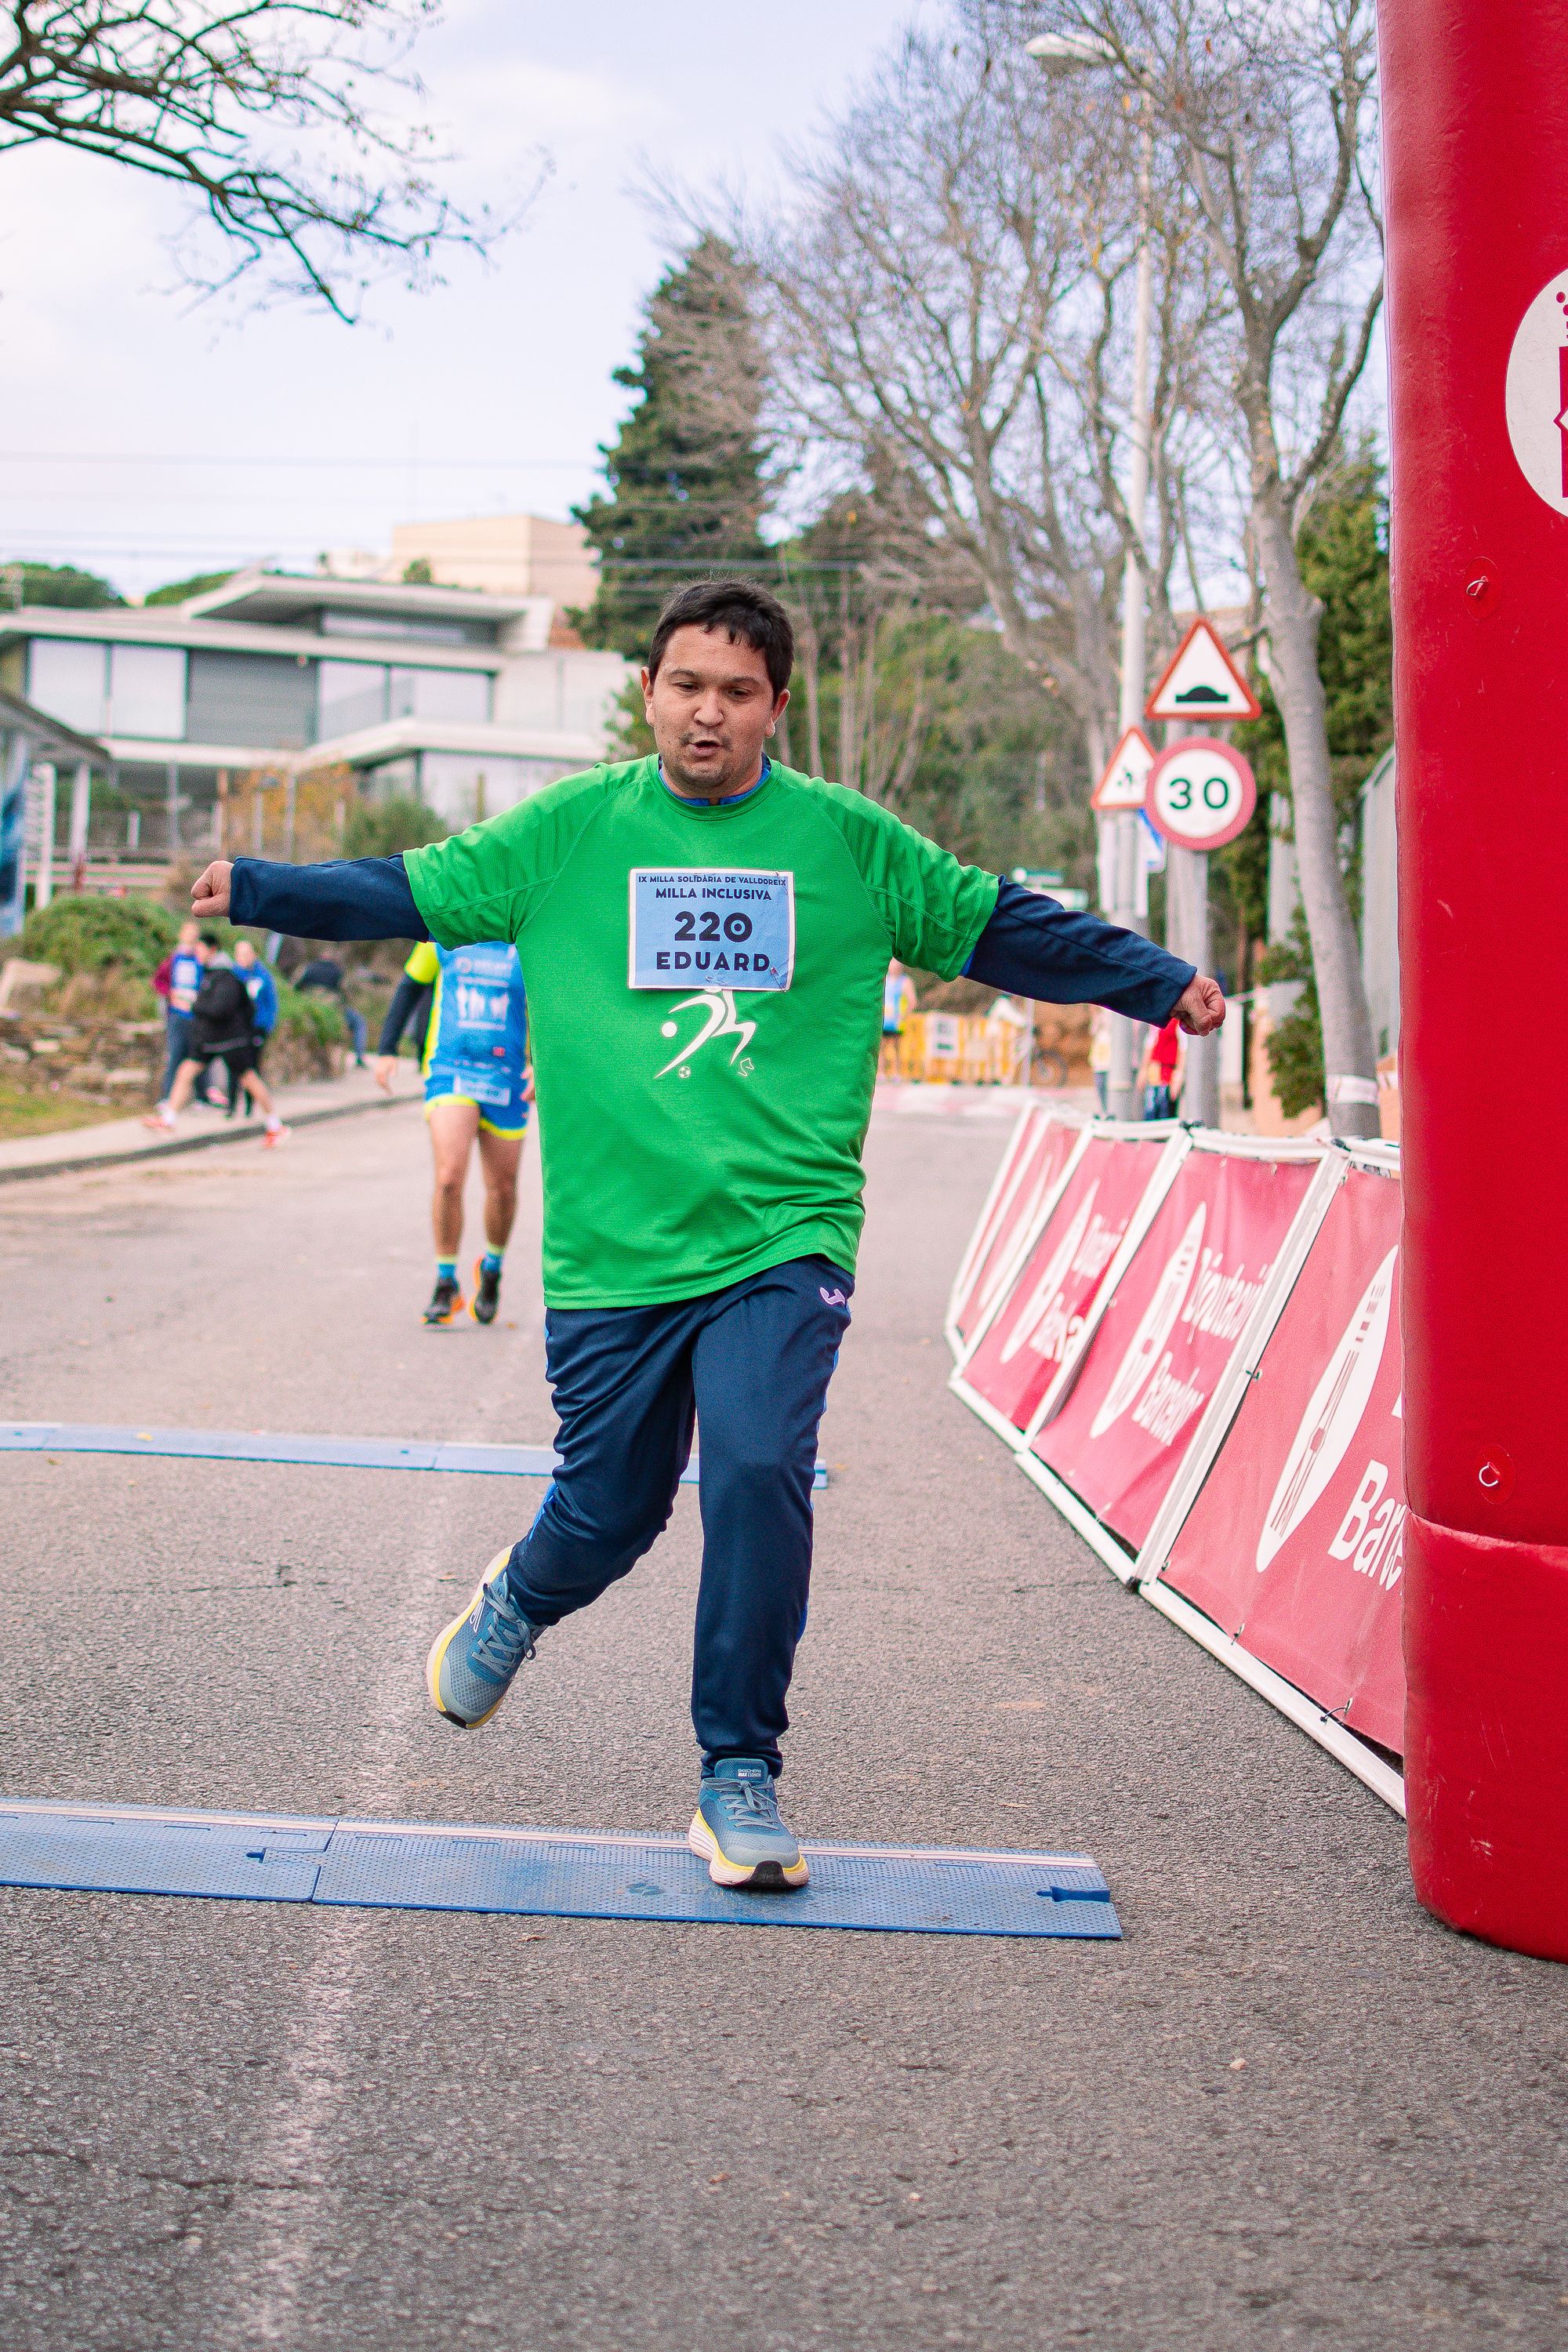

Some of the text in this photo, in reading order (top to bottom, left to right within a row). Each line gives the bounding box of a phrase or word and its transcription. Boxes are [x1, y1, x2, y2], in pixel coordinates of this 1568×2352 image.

[1169, 778, 1229, 810] 30
[739, 877, 786, 886] VALLDOREIX
[655, 887, 772, 901] MILLA INCLUSIVA
[674, 910, 753, 943] 220
[656, 951, 771, 972] EDUARD
